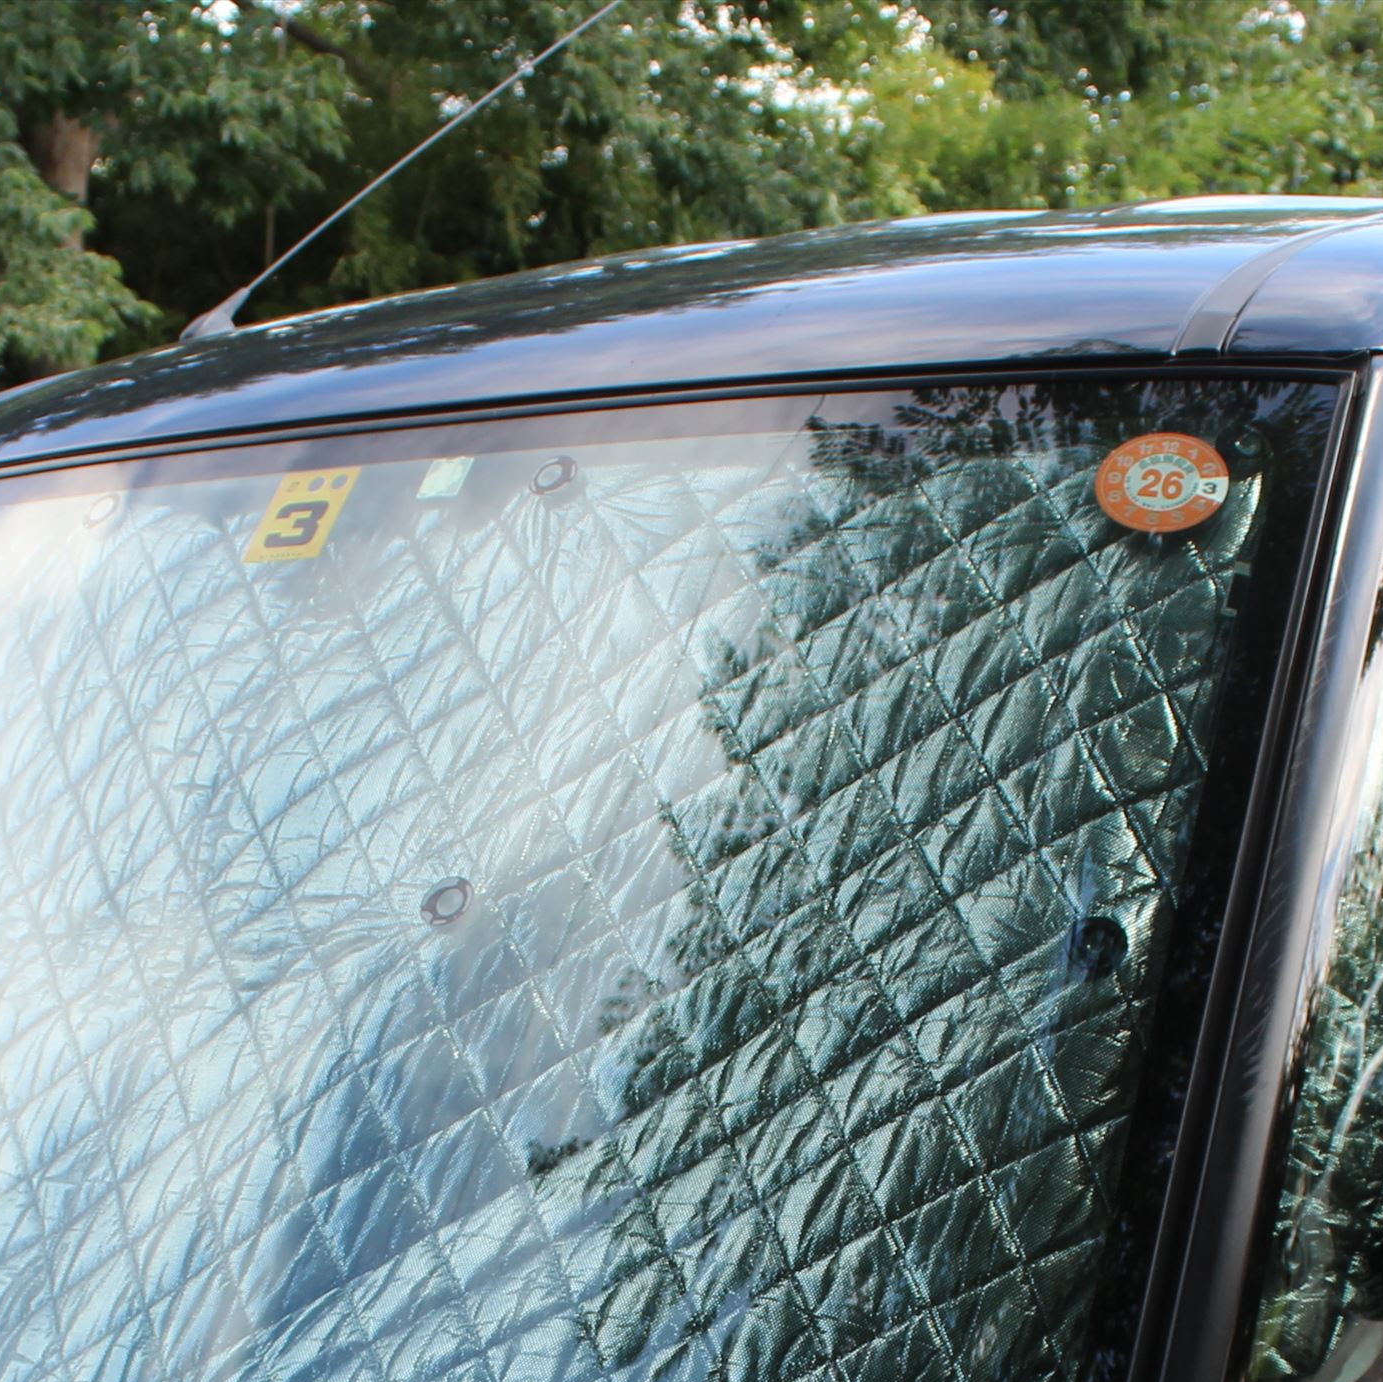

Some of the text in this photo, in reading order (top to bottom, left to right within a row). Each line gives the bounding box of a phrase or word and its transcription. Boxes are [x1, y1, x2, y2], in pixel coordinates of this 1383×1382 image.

[1137, 469, 1185, 500] 26
[1201, 482, 1218, 495] 3
[265, 500, 329, 548] 3
